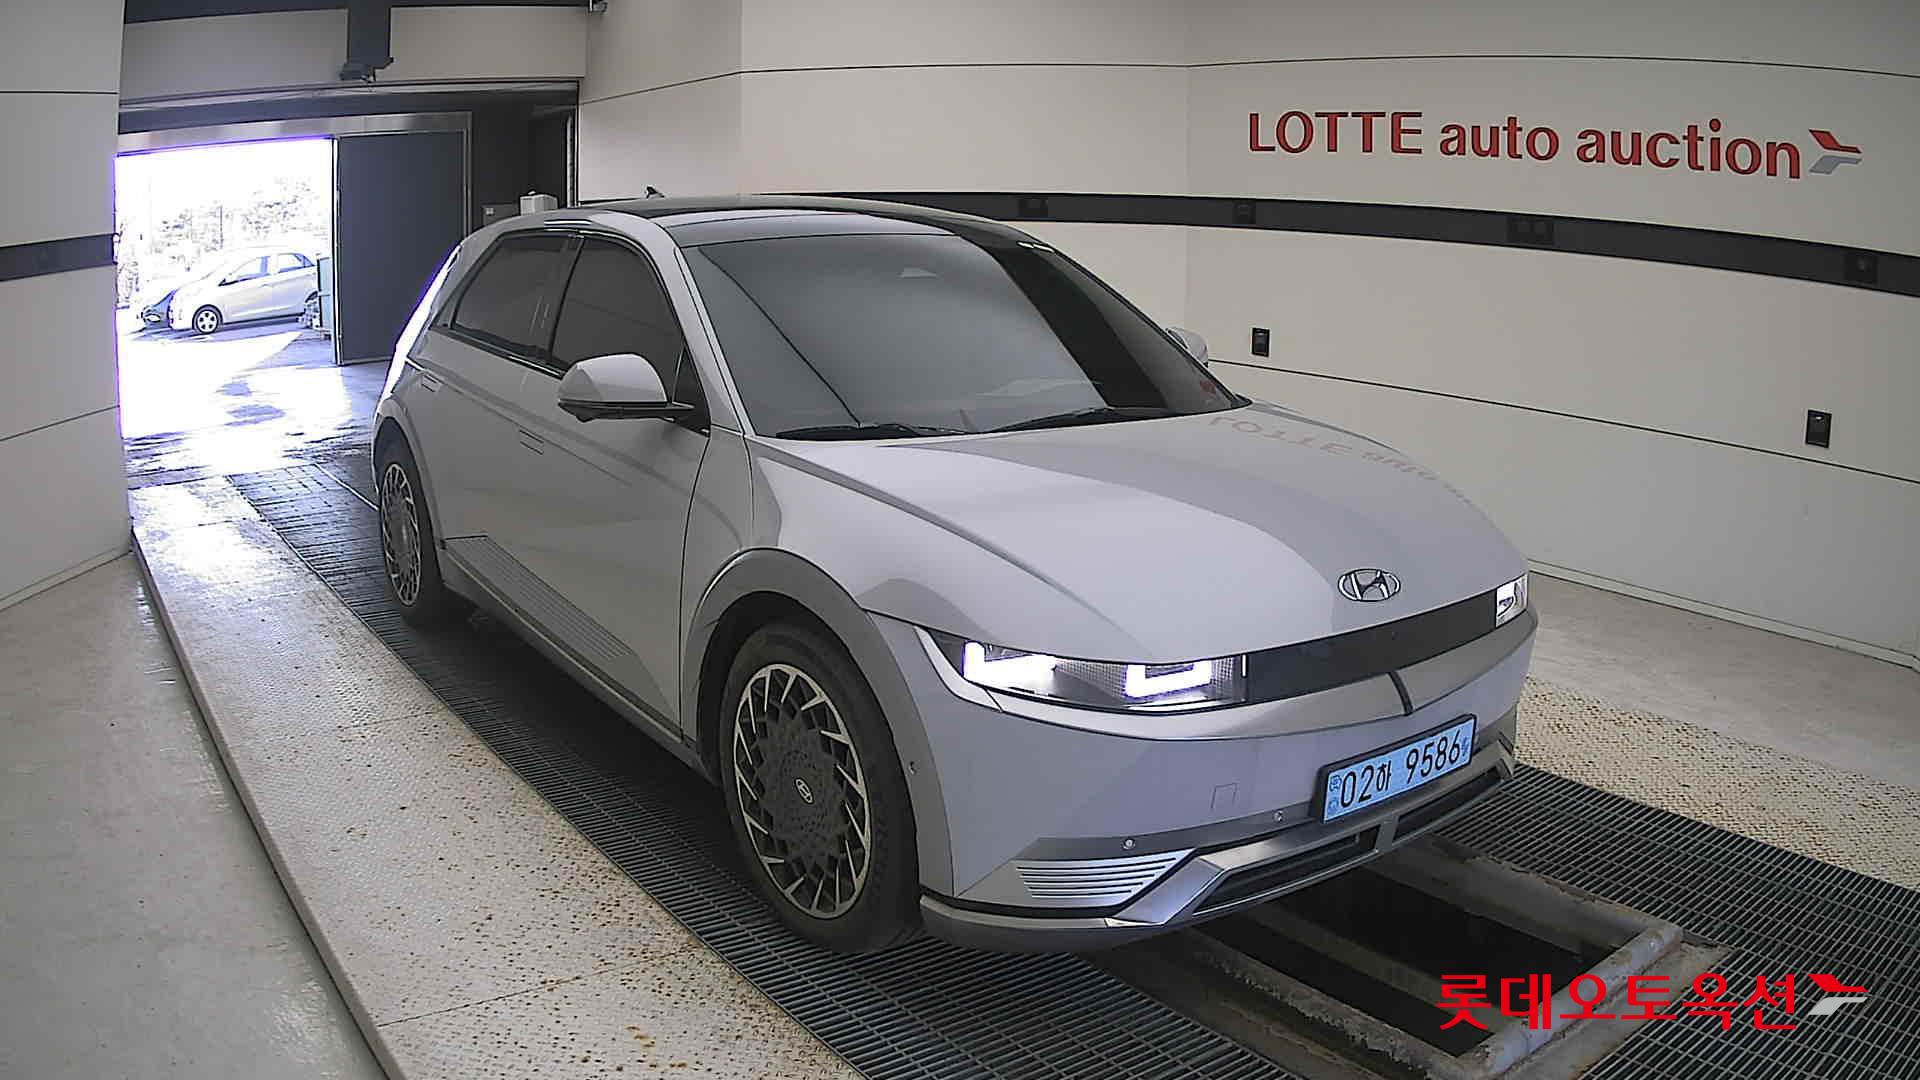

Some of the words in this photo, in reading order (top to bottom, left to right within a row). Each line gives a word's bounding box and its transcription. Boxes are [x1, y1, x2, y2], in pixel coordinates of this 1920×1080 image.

[1248, 111, 1423, 155] LOTTE
[1439, 116, 1560, 161] auto
[1575, 118, 1802, 180] auction
[1340, 759, 1392, 808] 02하
[1406, 730, 1462, 785] 9586
